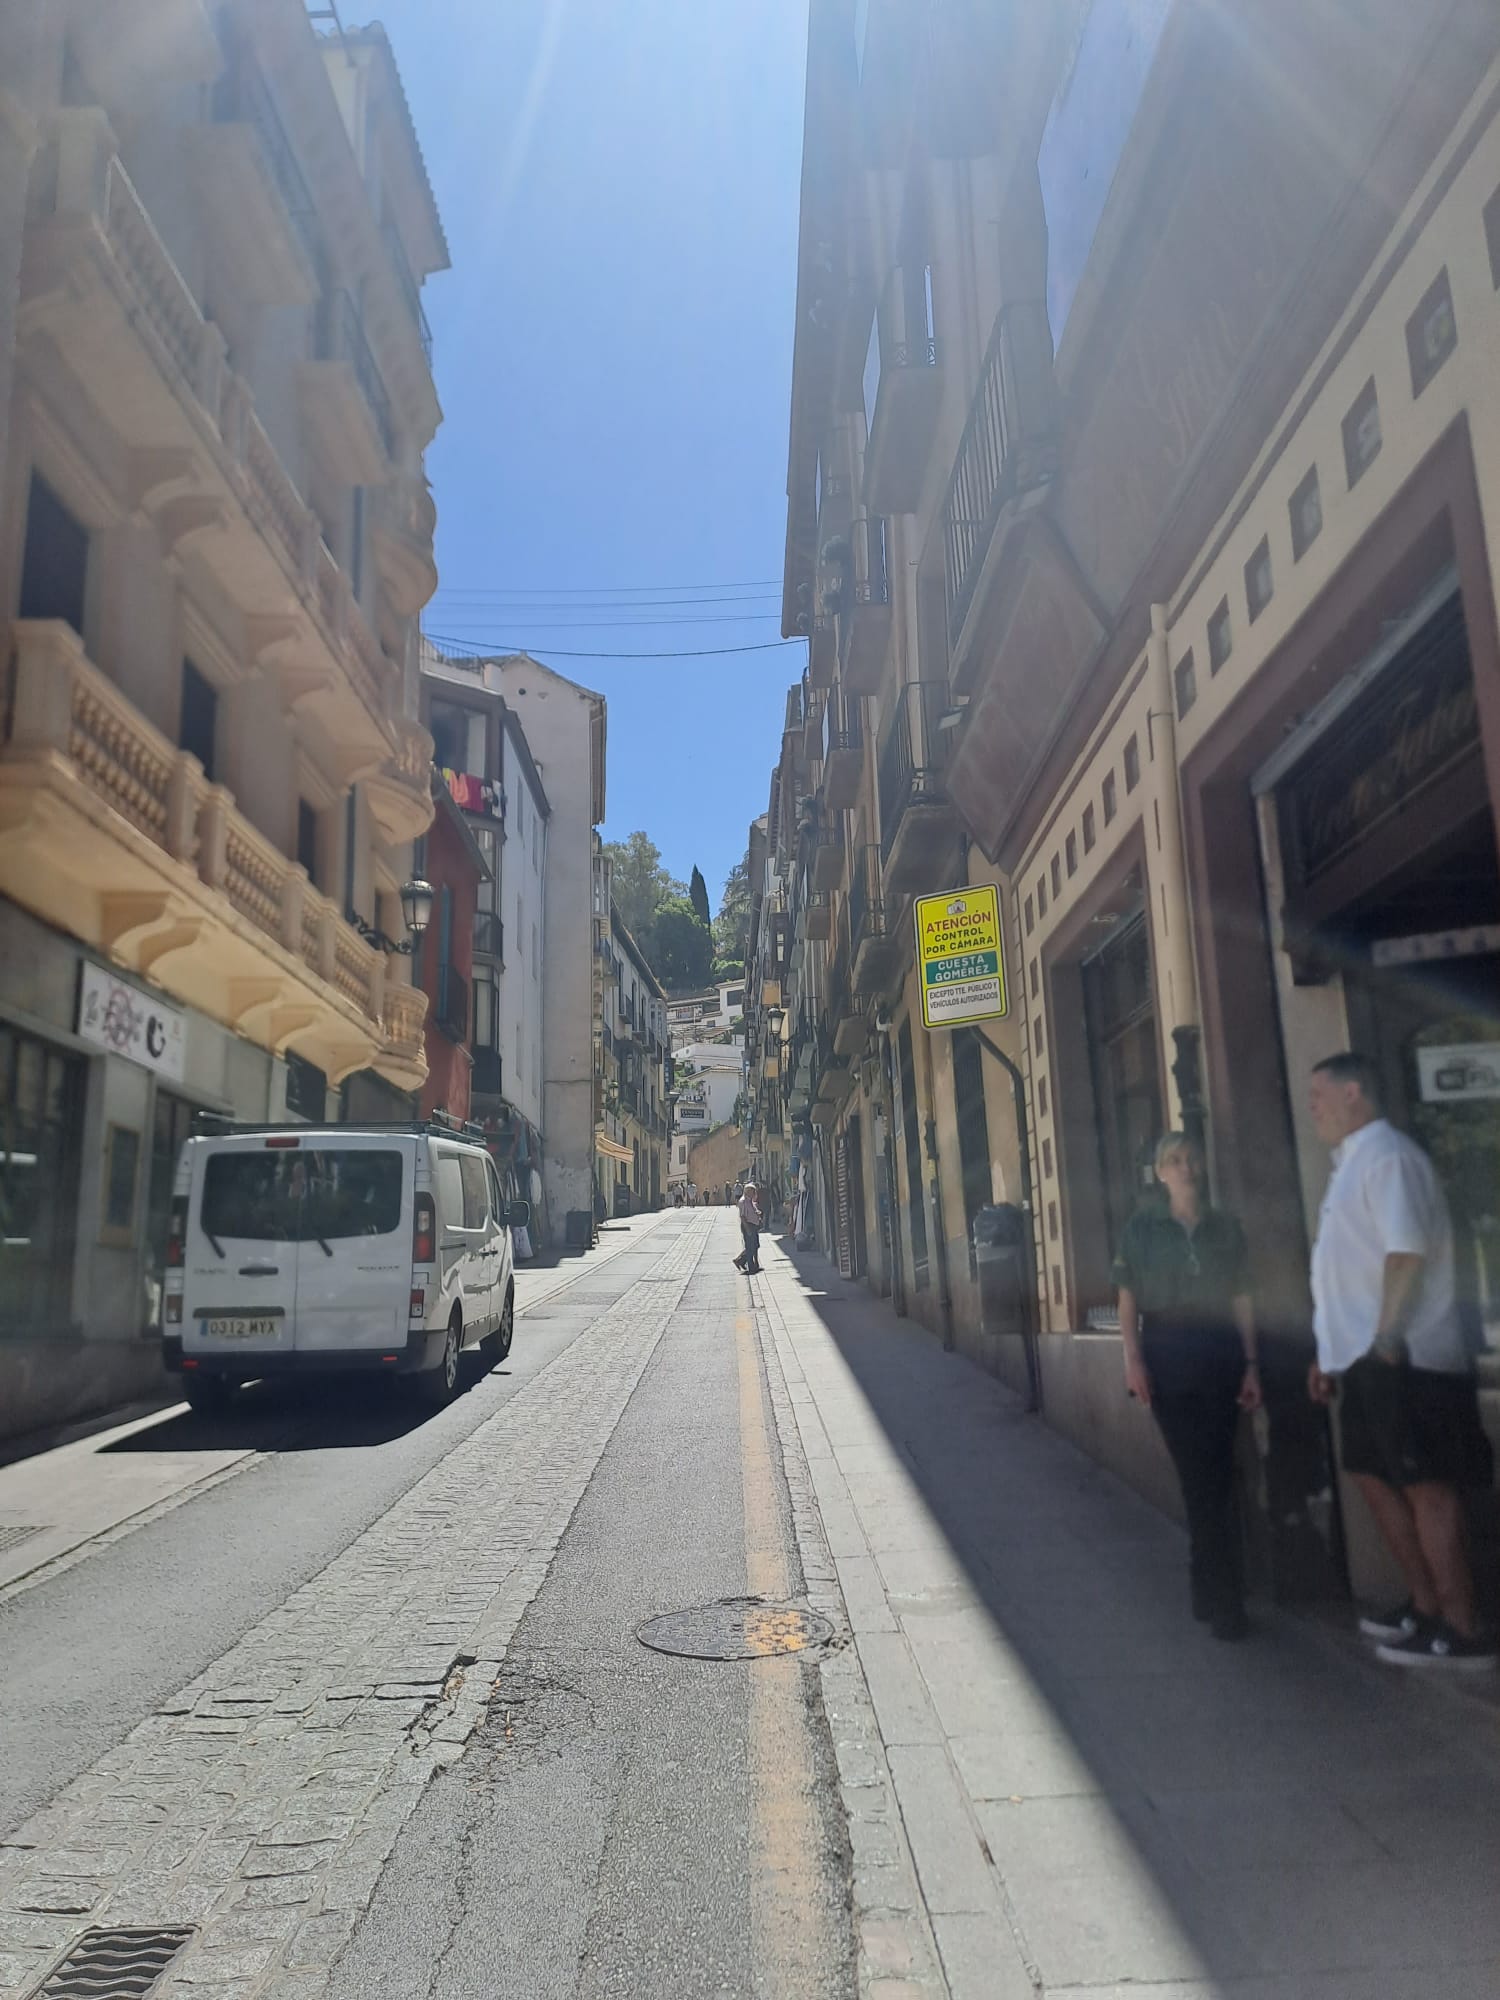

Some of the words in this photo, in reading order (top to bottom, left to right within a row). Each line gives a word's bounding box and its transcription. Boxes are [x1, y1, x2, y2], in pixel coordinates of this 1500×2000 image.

[926, 909, 991, 934] ATENCIÓN
[934, 927, 984, 942] CONTROL
[926, 944, 946, 954] POR
[950, 936, 994, 951] CÁMARA
[938, 954, 985, 971] CUESTA
[935, 964, 990, 982] GOMÉREZ
[930, 989, 954, 999] EXCEPTO
[968, 982, 992, 993] PÚBLICO
[930, 997, 959, 1008] VEHÍCULOS
[960, 992, 998, 1004] AUTORIZADOS
[210, 1321, 245, 1334] 0312
